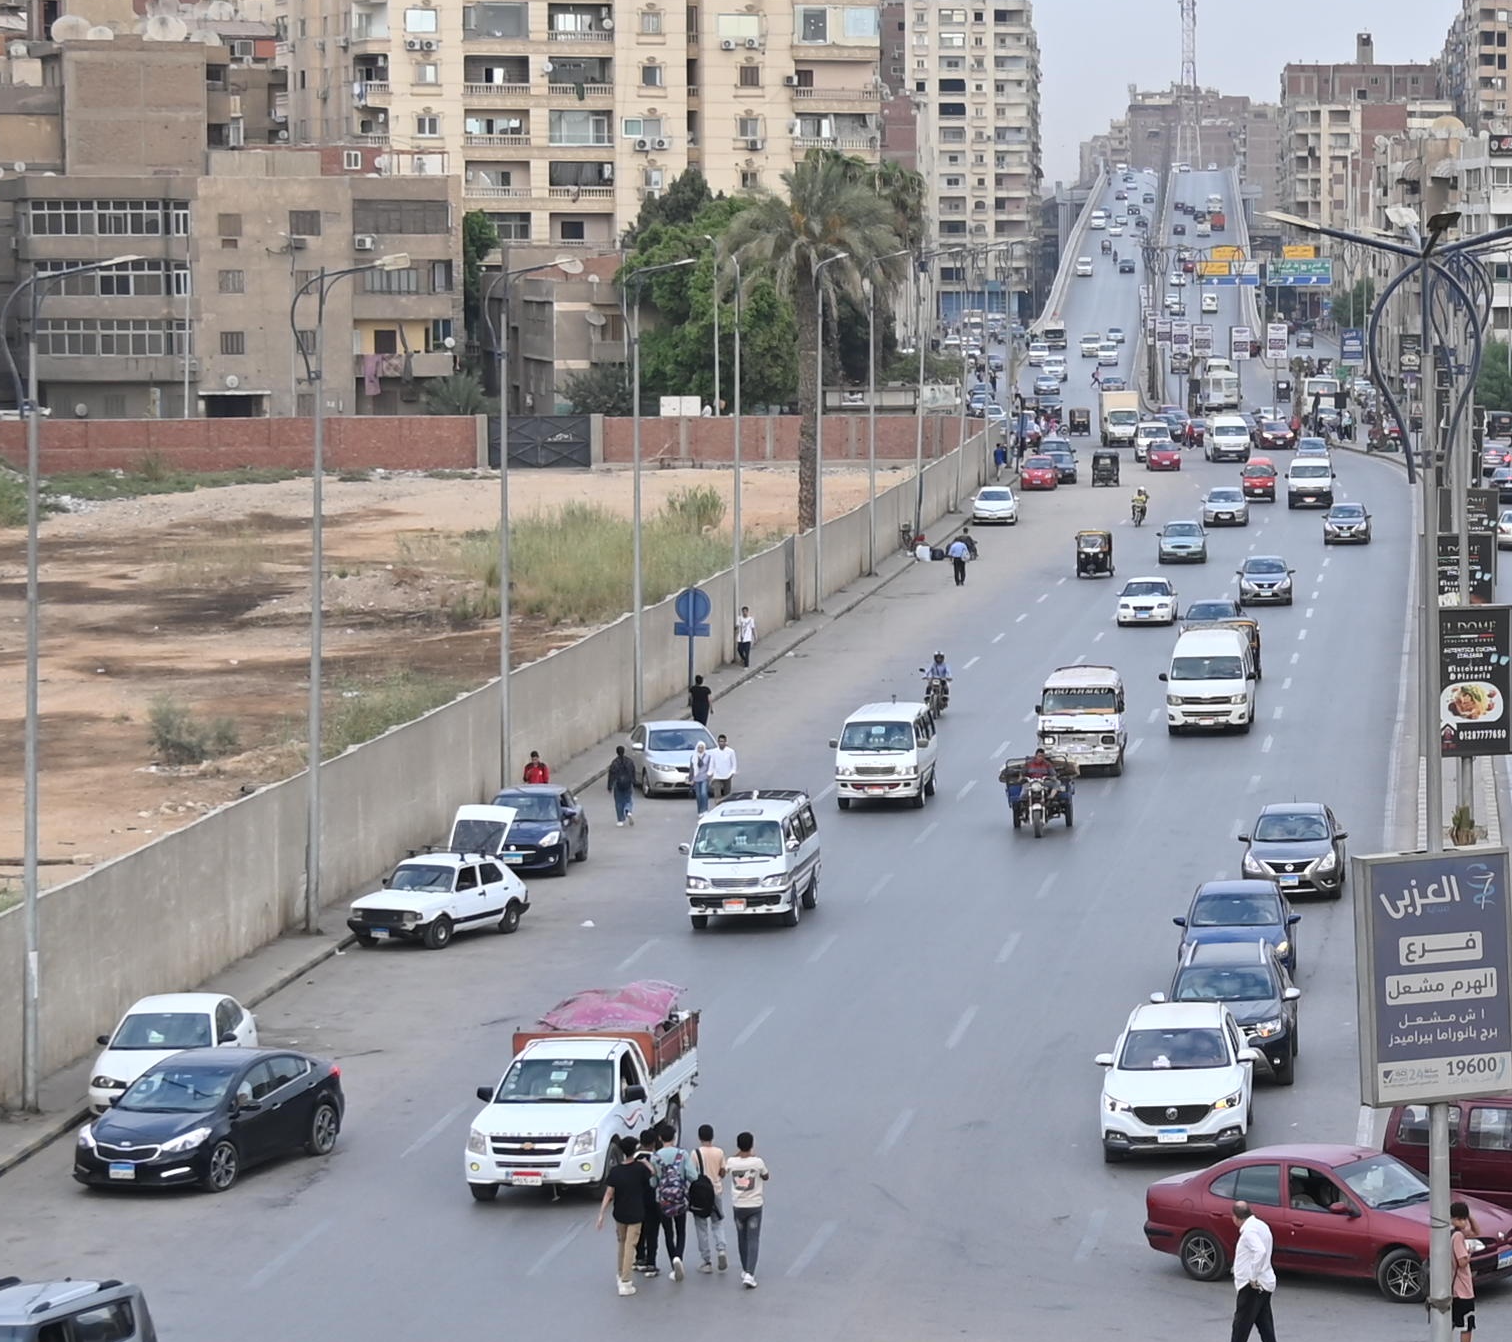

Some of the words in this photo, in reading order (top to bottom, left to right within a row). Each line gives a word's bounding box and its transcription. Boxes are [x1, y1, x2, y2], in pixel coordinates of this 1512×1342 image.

[1405, 933, 1477, 963] فرع
[1388, 977, 1445, 1000] مشعل
[1451, 972, 1494, 997] الهرم
[1399, 1010, 1457, 1029] مشعل
[1388, 1030, 1433, 1048] بيراميدز
[1437, 1025, 1477, 1043] بانوراما
[1480, 1026, 1498, 1041] برج
[1446, 1056, 1497, 1077] 19600
